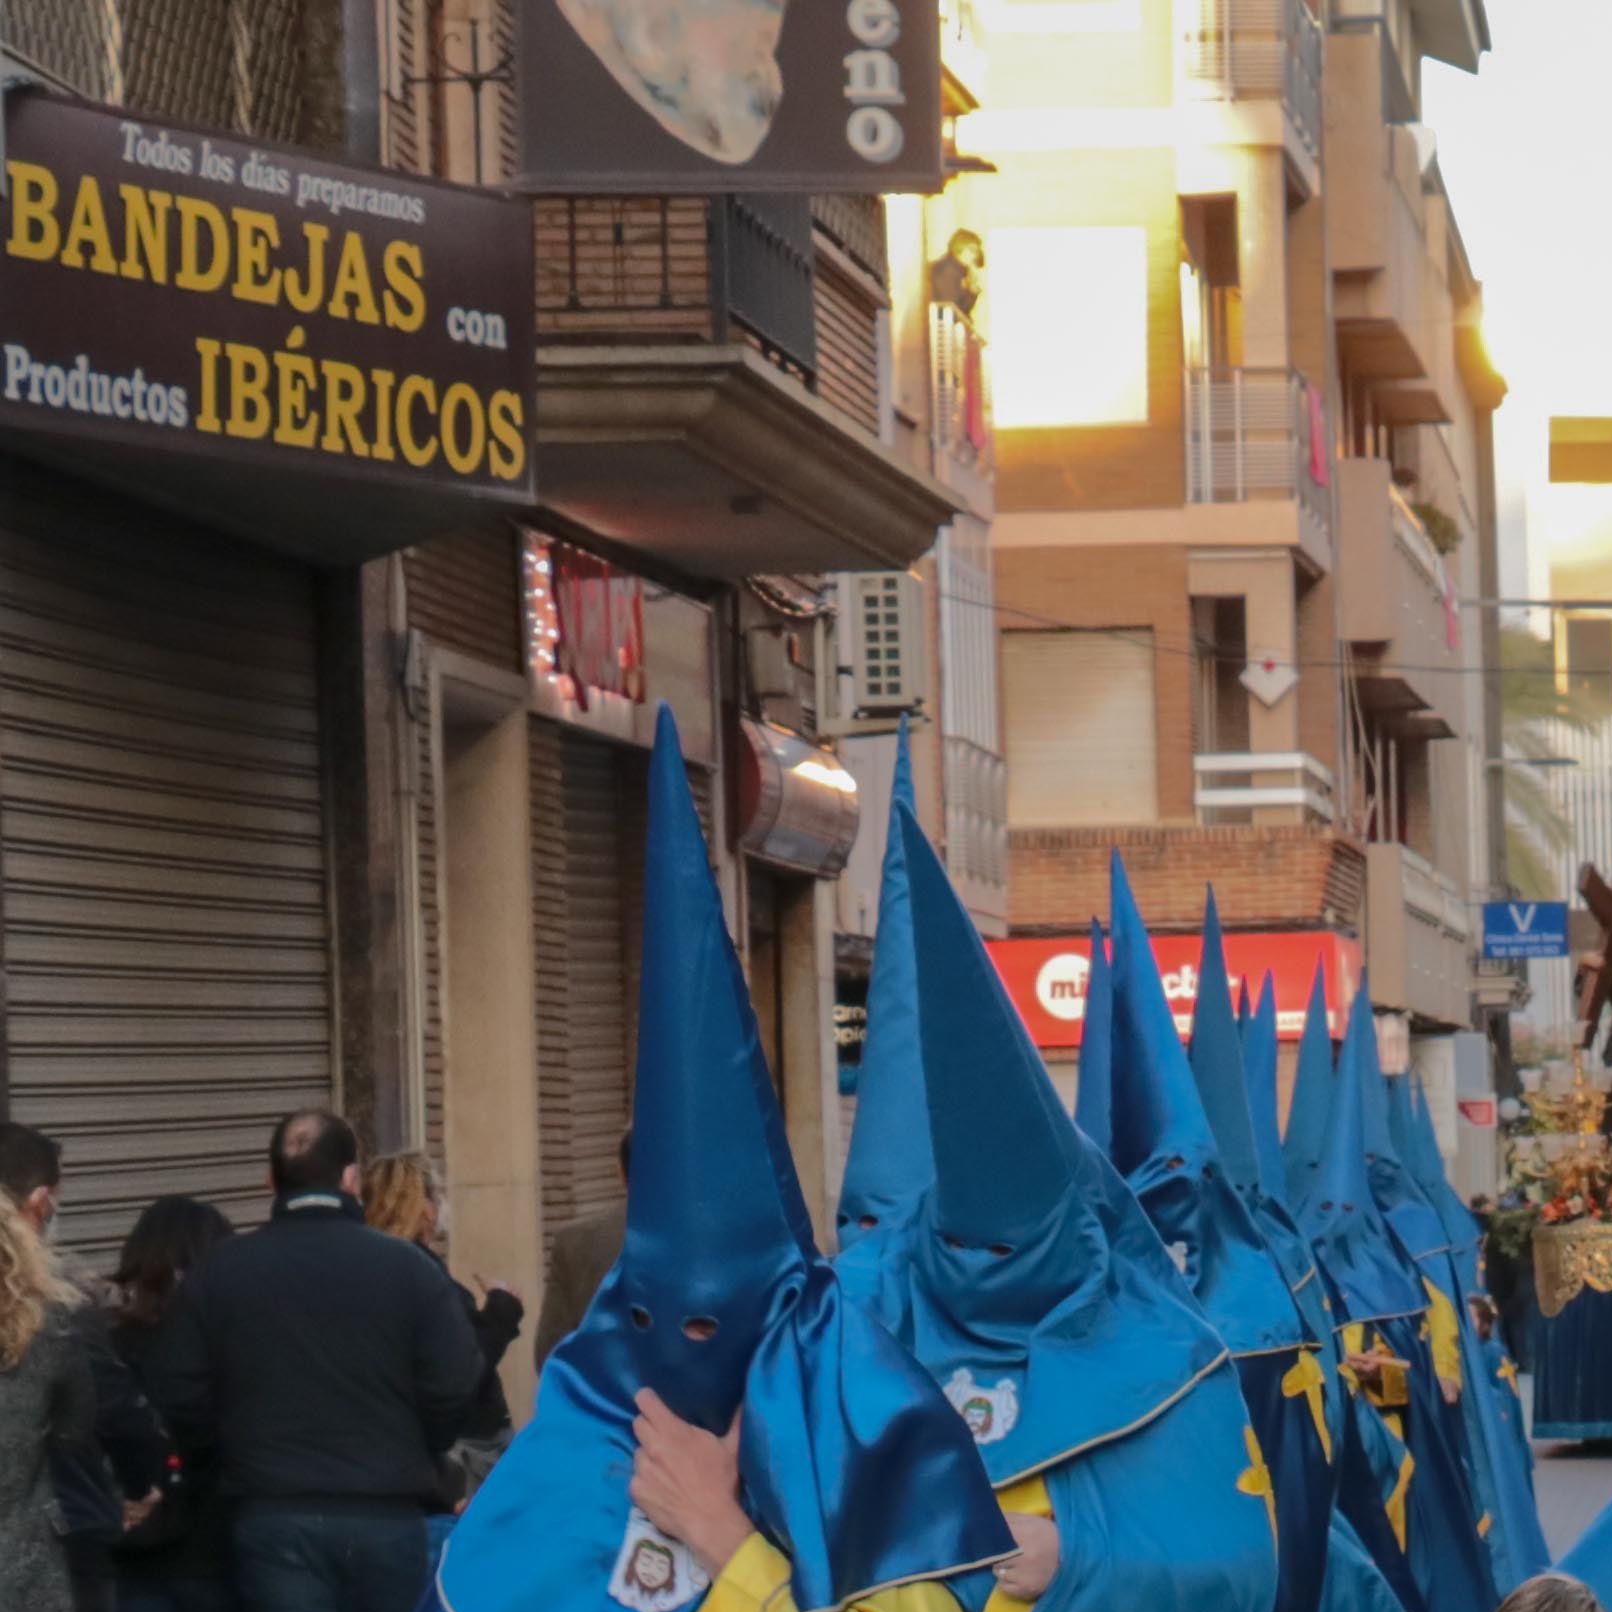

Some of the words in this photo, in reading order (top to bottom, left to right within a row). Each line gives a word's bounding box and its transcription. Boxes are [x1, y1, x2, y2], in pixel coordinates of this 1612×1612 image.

[120, 122, 193, 174] Todos
[200, 140, 236, 184] los
[297, 171, 426, 225] preparamos
[6, 160, 427, 333] BANDEJAS
[446, 306, 508, 350] con
[3, 344, 188, 428] Productos
[196, 325, 525, 482] IBÉRICOS
